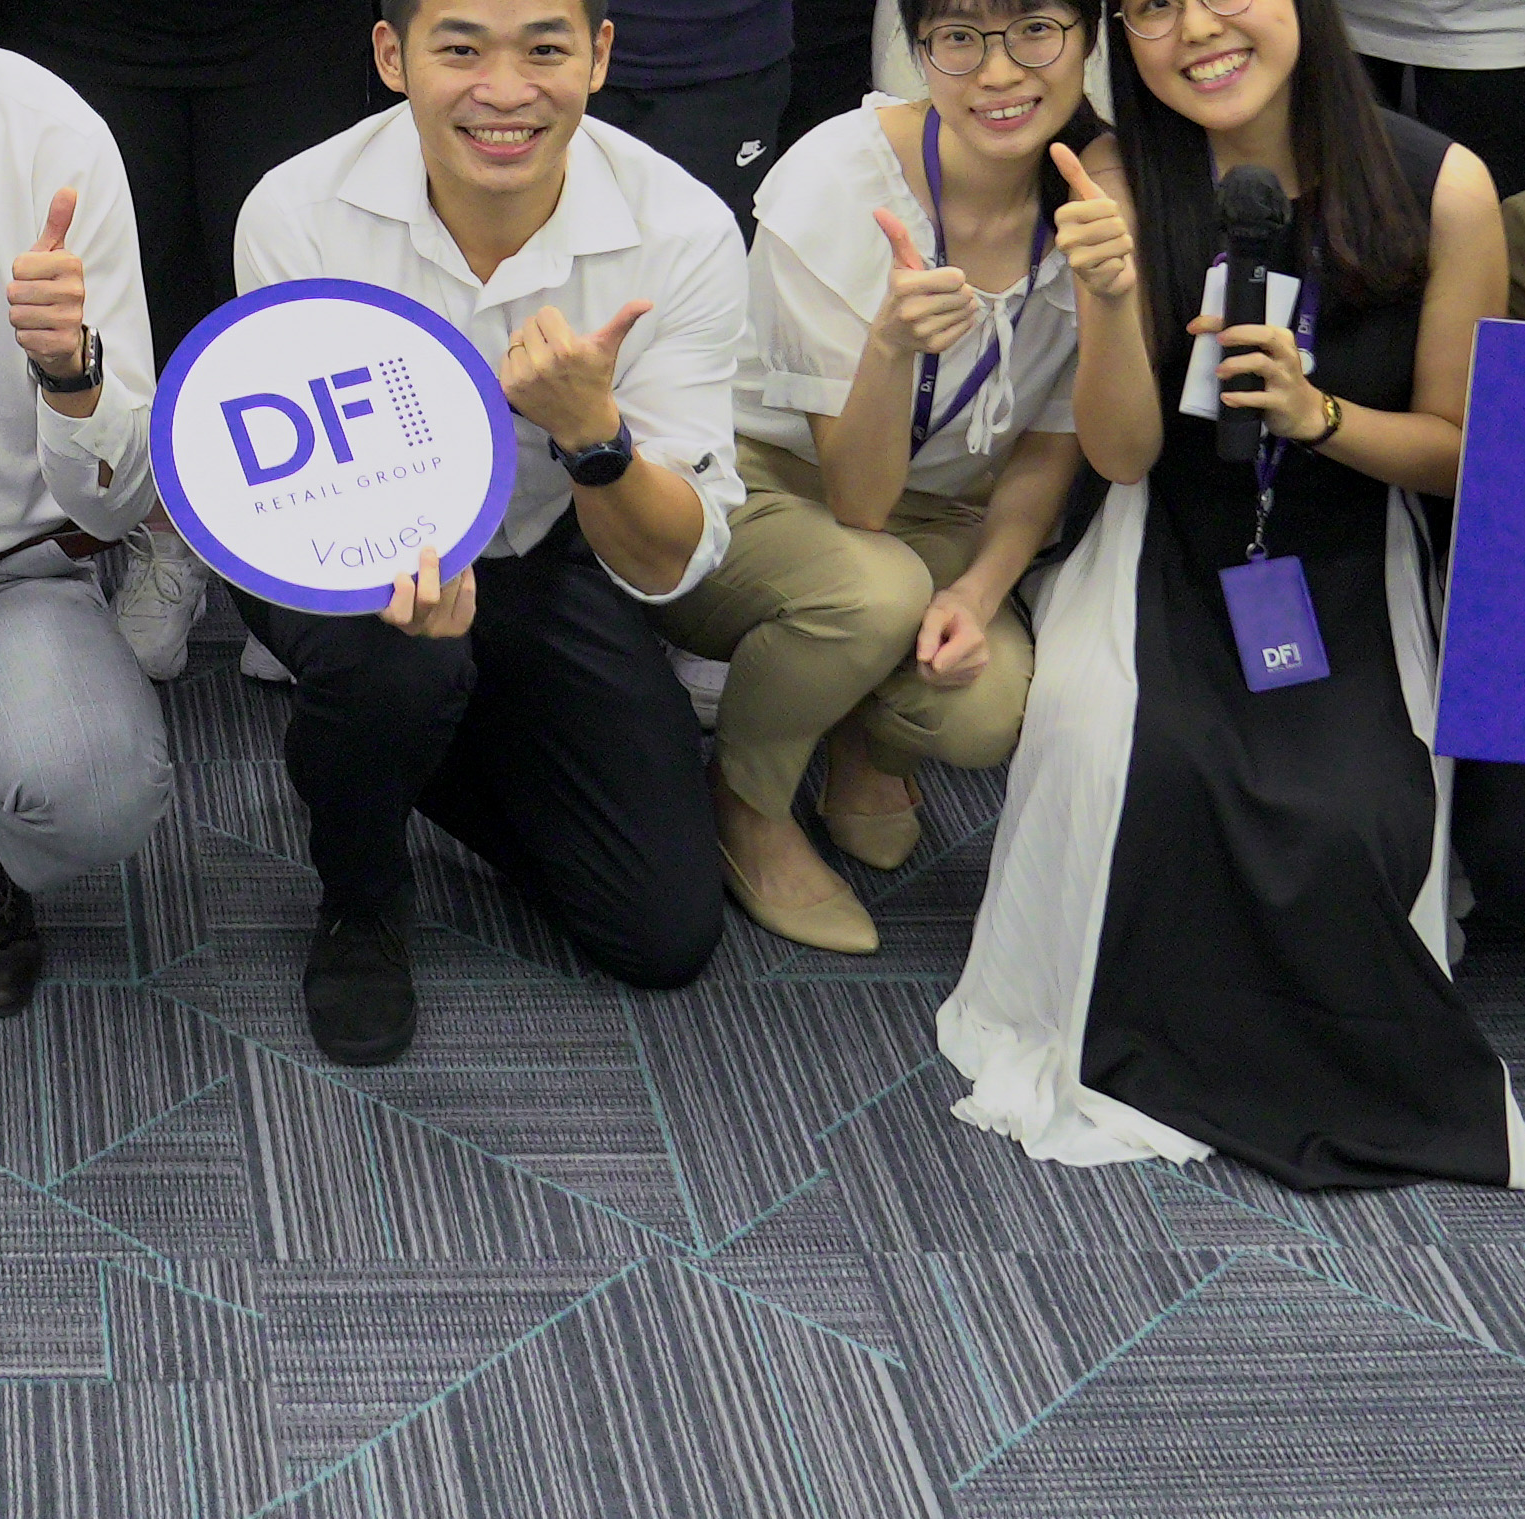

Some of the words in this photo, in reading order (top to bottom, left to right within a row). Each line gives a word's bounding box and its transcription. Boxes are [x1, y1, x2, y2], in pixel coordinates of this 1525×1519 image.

[219, 356, 433, 487] DFI
[254, 485, 342, 514] RETAIL
[356, 456, 443, 489] GROUP
[311, 513, 438, 567] Values
[1262, 642, 1301, 668] DFI
